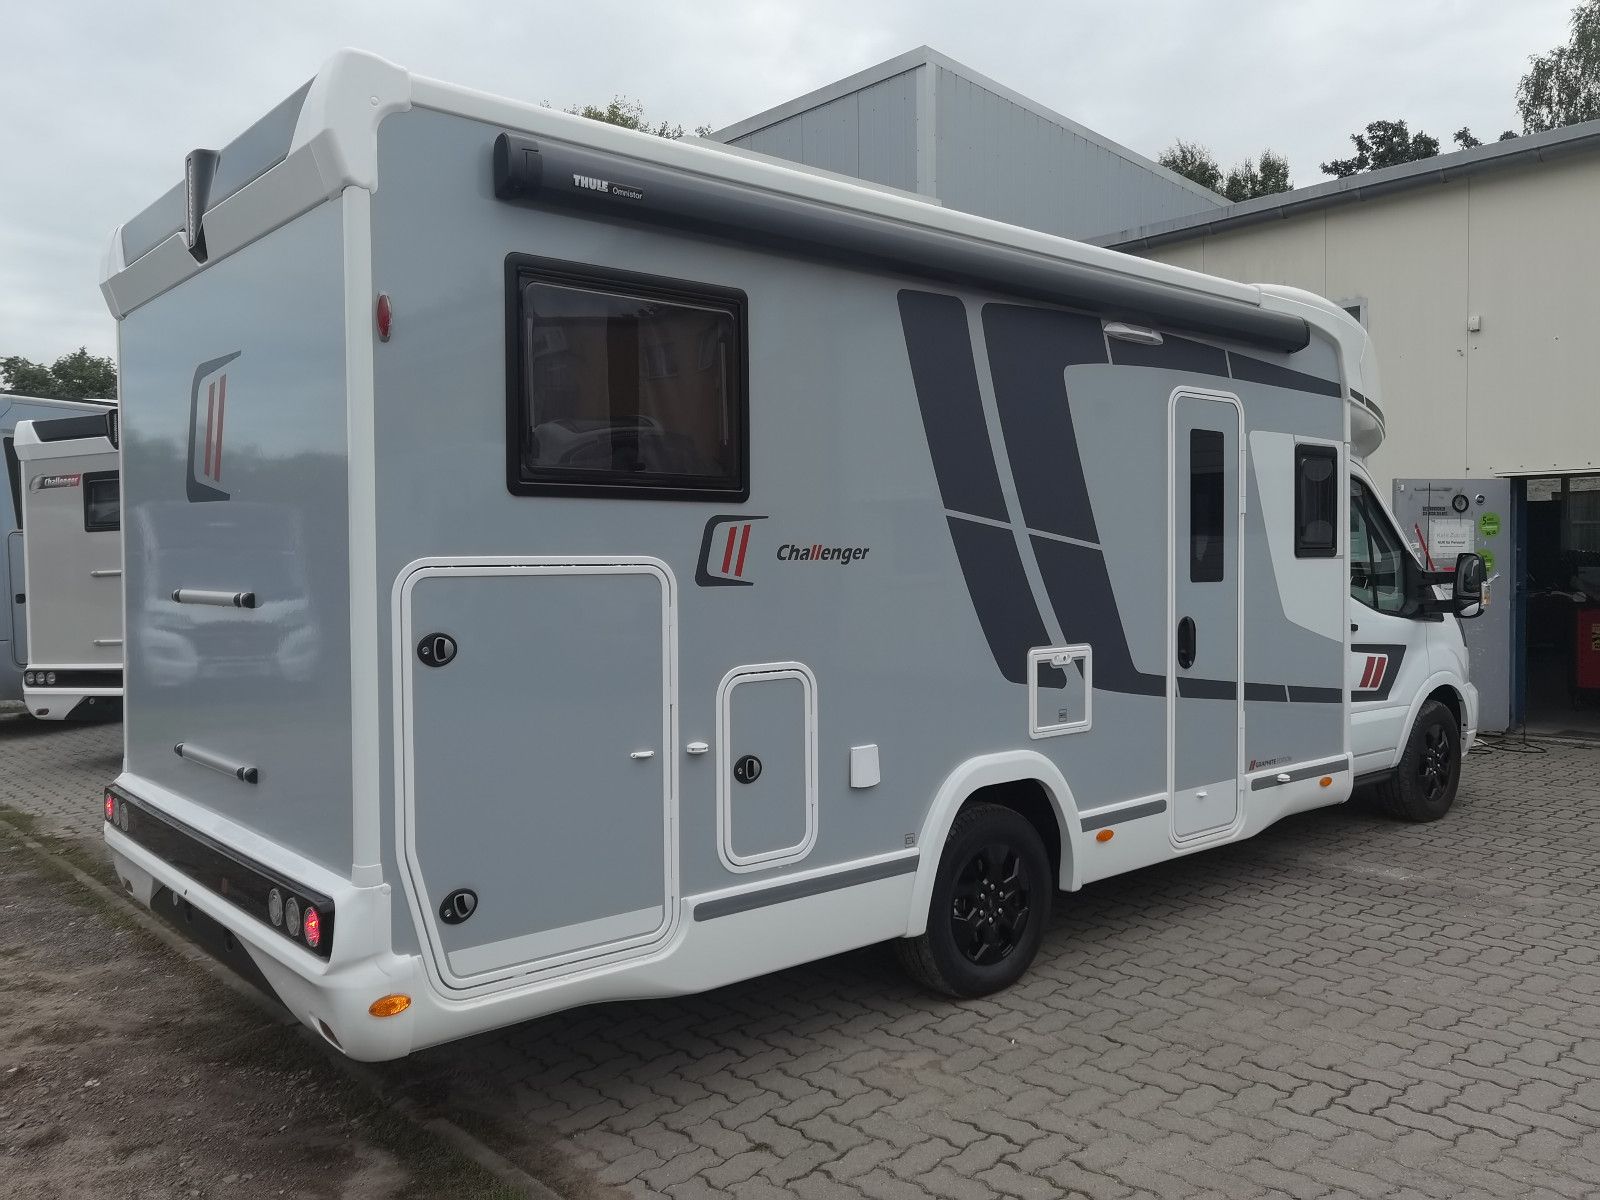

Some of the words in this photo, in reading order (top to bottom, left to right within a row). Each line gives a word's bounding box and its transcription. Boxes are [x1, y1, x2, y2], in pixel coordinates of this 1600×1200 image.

[573, 174, 609, 193] THULE
[612, 186, 643, 200] Omnistor
[44, 476, 79, 487] Challenger
[776, 544, 870, 565] Challenger
[1256, 759, 1277, 768] GRAPHITE
